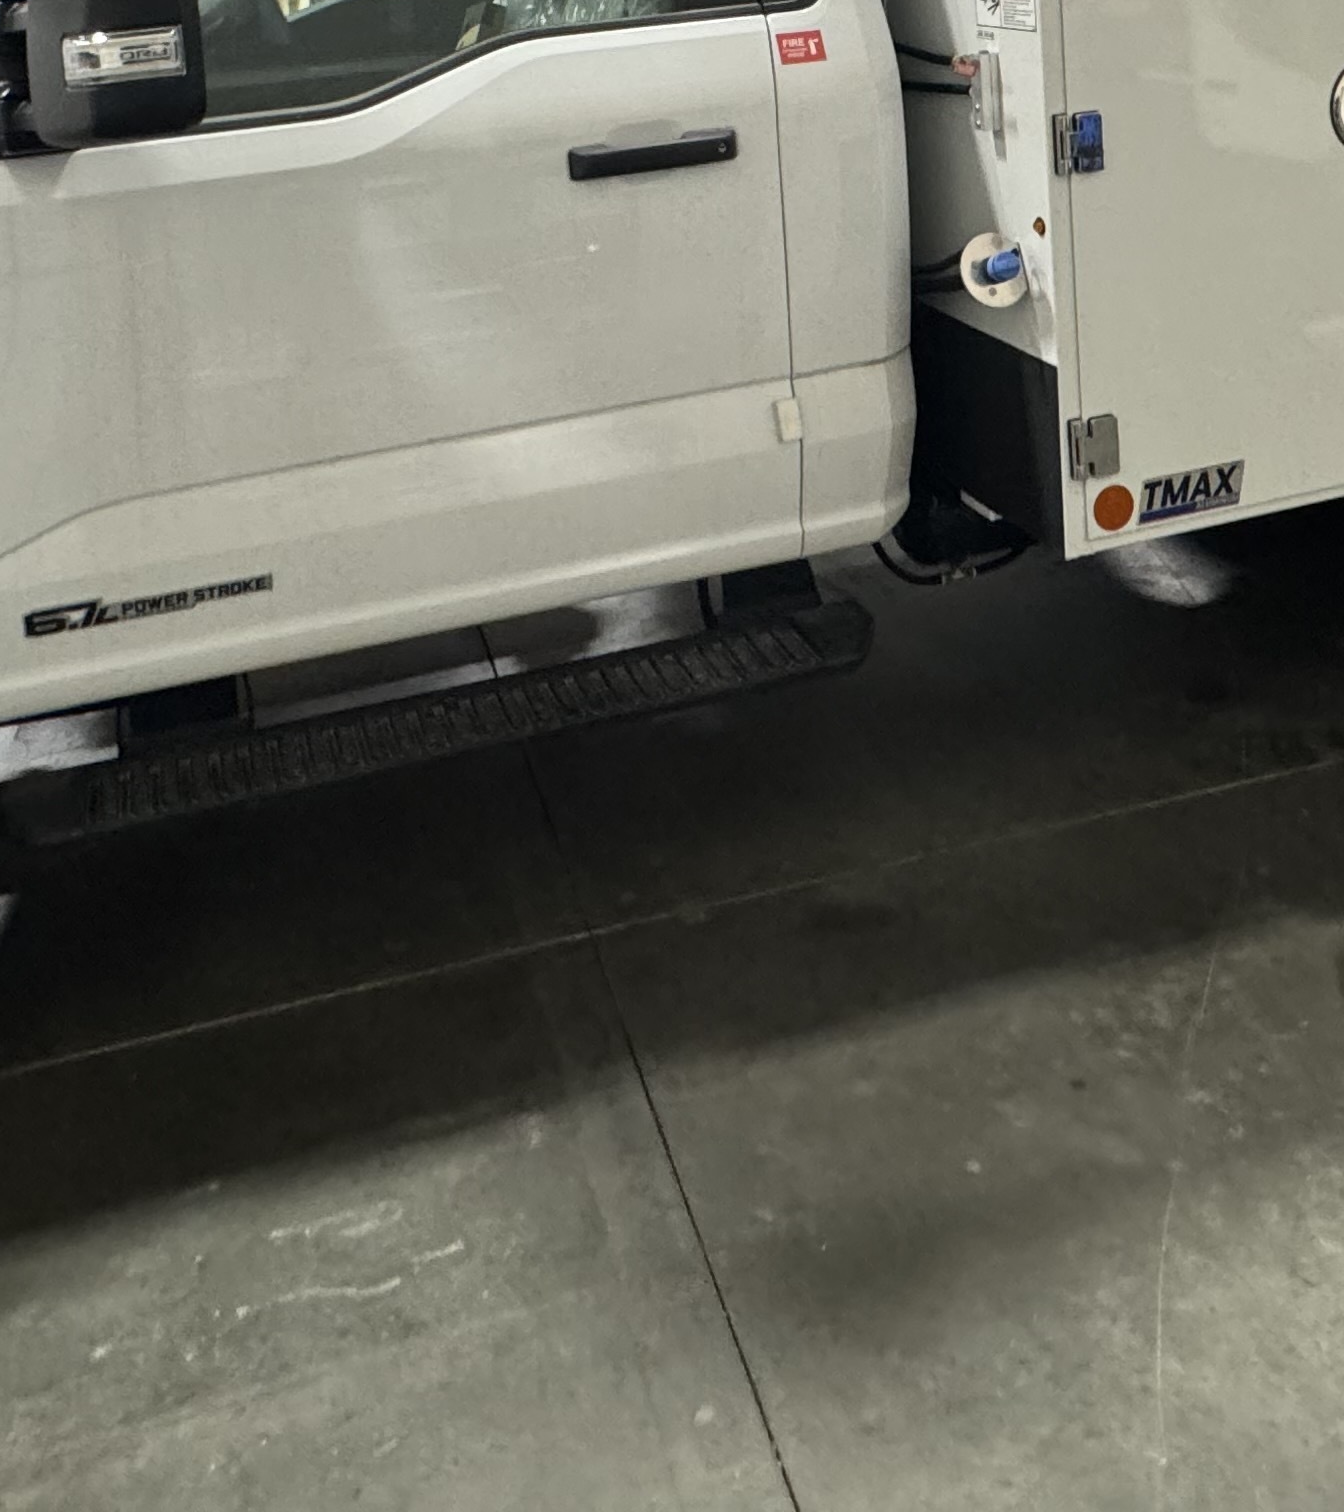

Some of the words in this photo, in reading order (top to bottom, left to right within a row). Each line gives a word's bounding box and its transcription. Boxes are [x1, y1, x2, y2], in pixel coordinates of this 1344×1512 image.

[1143, 464, 1237, 512] TMAX
[121, 590, 189, 616] POWER
[193, 575, 267, 602] STROKE
